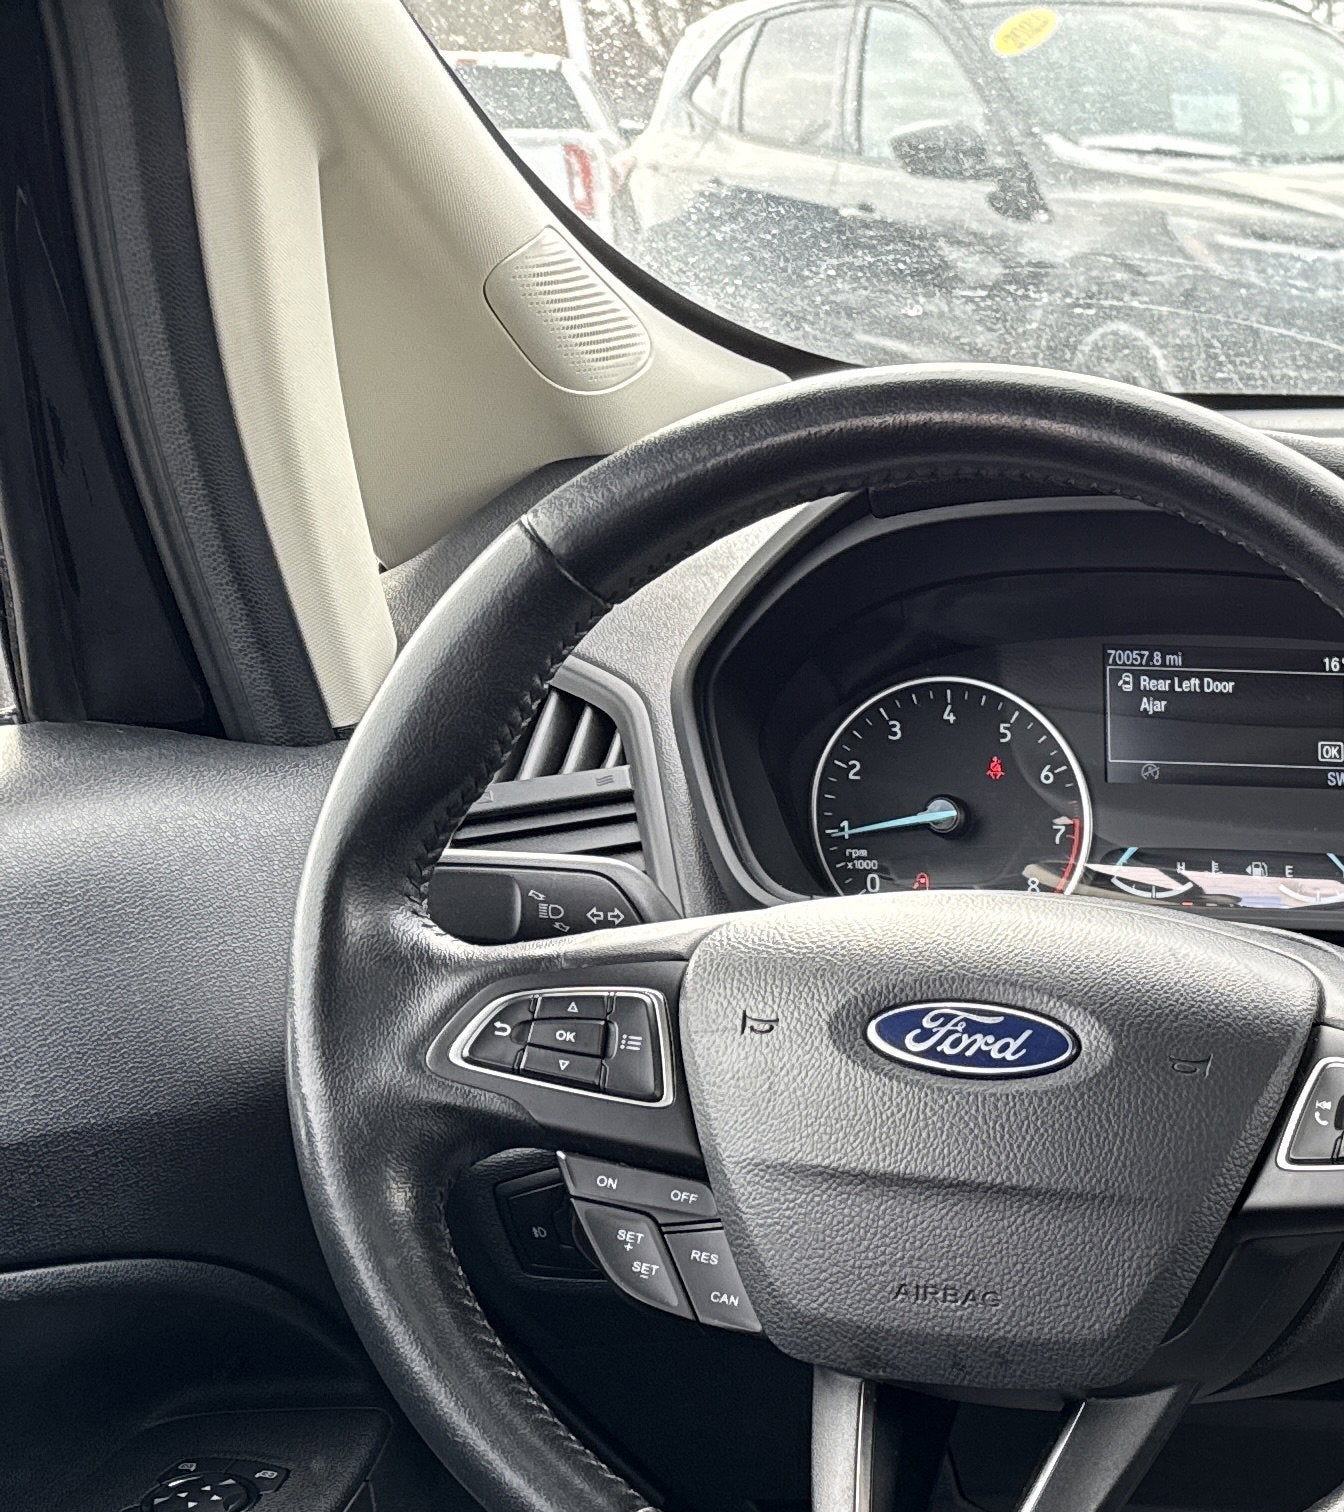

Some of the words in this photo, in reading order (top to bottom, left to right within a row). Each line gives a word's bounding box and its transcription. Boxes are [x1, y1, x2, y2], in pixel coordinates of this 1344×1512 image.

[1107, 650, 1161, 665] 70057.8
[1166, 655, 1181, 665] mi
[1141, 676, 1171, 691] Rear
[1174, 677, 1200, 692] Left
[1204, 678, 1235, 693] Door
[1140, 697, 1167, 714] Ajar
[943, 705, 956, 723] 4
[888, 721, 901, 740] 3
[1000, 724, 1011, 742] 5
[1322, 746, 1340, 759] OK
[849, 760, 860, 779] 2
[1041, 765, 1053, 784] 6
[839, 820, 849, 839] 1
[1053, 826, 1065, 844] 7
[847, 860, 878, 870] x1000
[868, 874, 879, 892] 0
[1028, 877, 1039, 893] 8
[556, 1031, 575, 1042] OK
[597, 1176, 617, 1189] ON
[671, 1190, 698, 1203] OFF
[617, 1229, 644, 1244] SET
[691, 1250, 718, 1264] RES
[632, 1261, 659, 1277] SET
[711, 1292, 739, 1306] CAN
[893, 1283, 1001, 1308] AIRBAG
